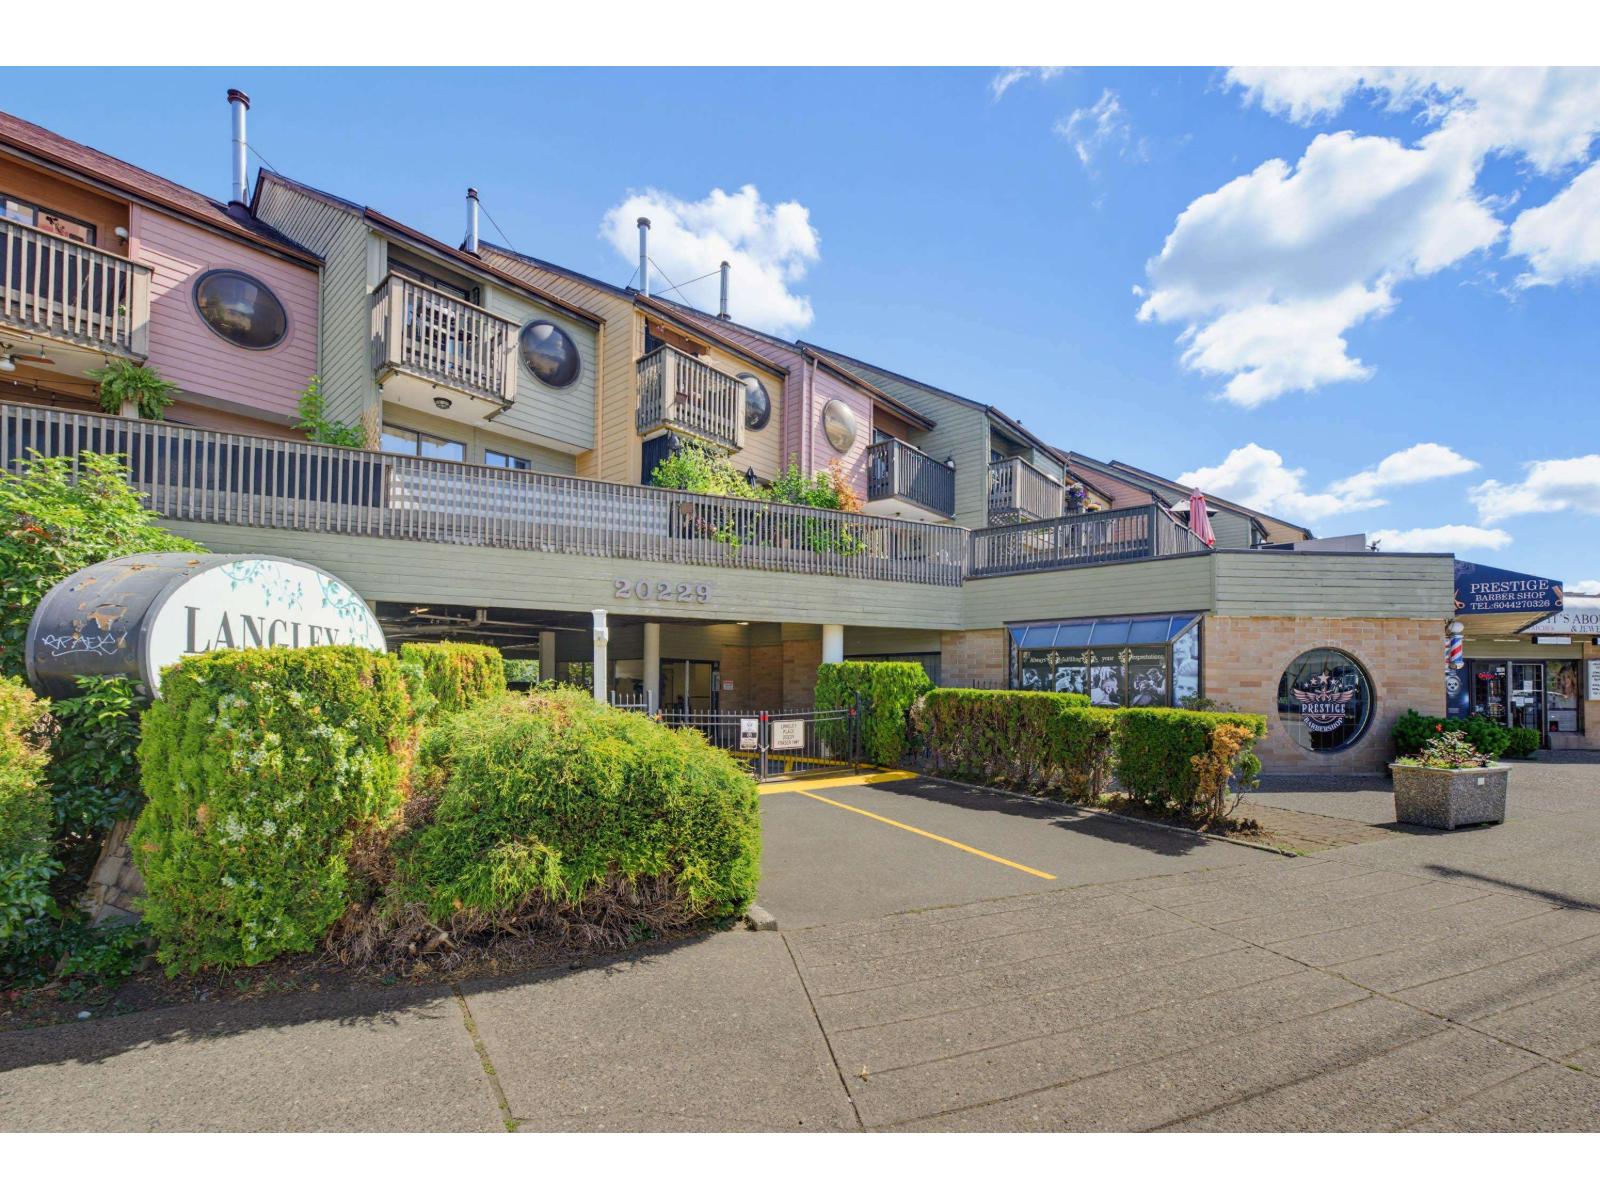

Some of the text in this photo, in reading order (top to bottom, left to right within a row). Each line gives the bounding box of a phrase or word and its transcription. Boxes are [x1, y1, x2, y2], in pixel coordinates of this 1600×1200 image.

[614, 577, 711, 603] 20229
[1470, 580, 1549, 594] PRESTIGE
[1475, 591, 1546, 602] BARBER SHOP
[1573, 614, 1600, 625] ABO
[184, 606, 339, 653] LANGLEY
[1302, 703, 1345, 713] PRESTIGE
[1303, 716, 1343, 732] BARBERSHOP
